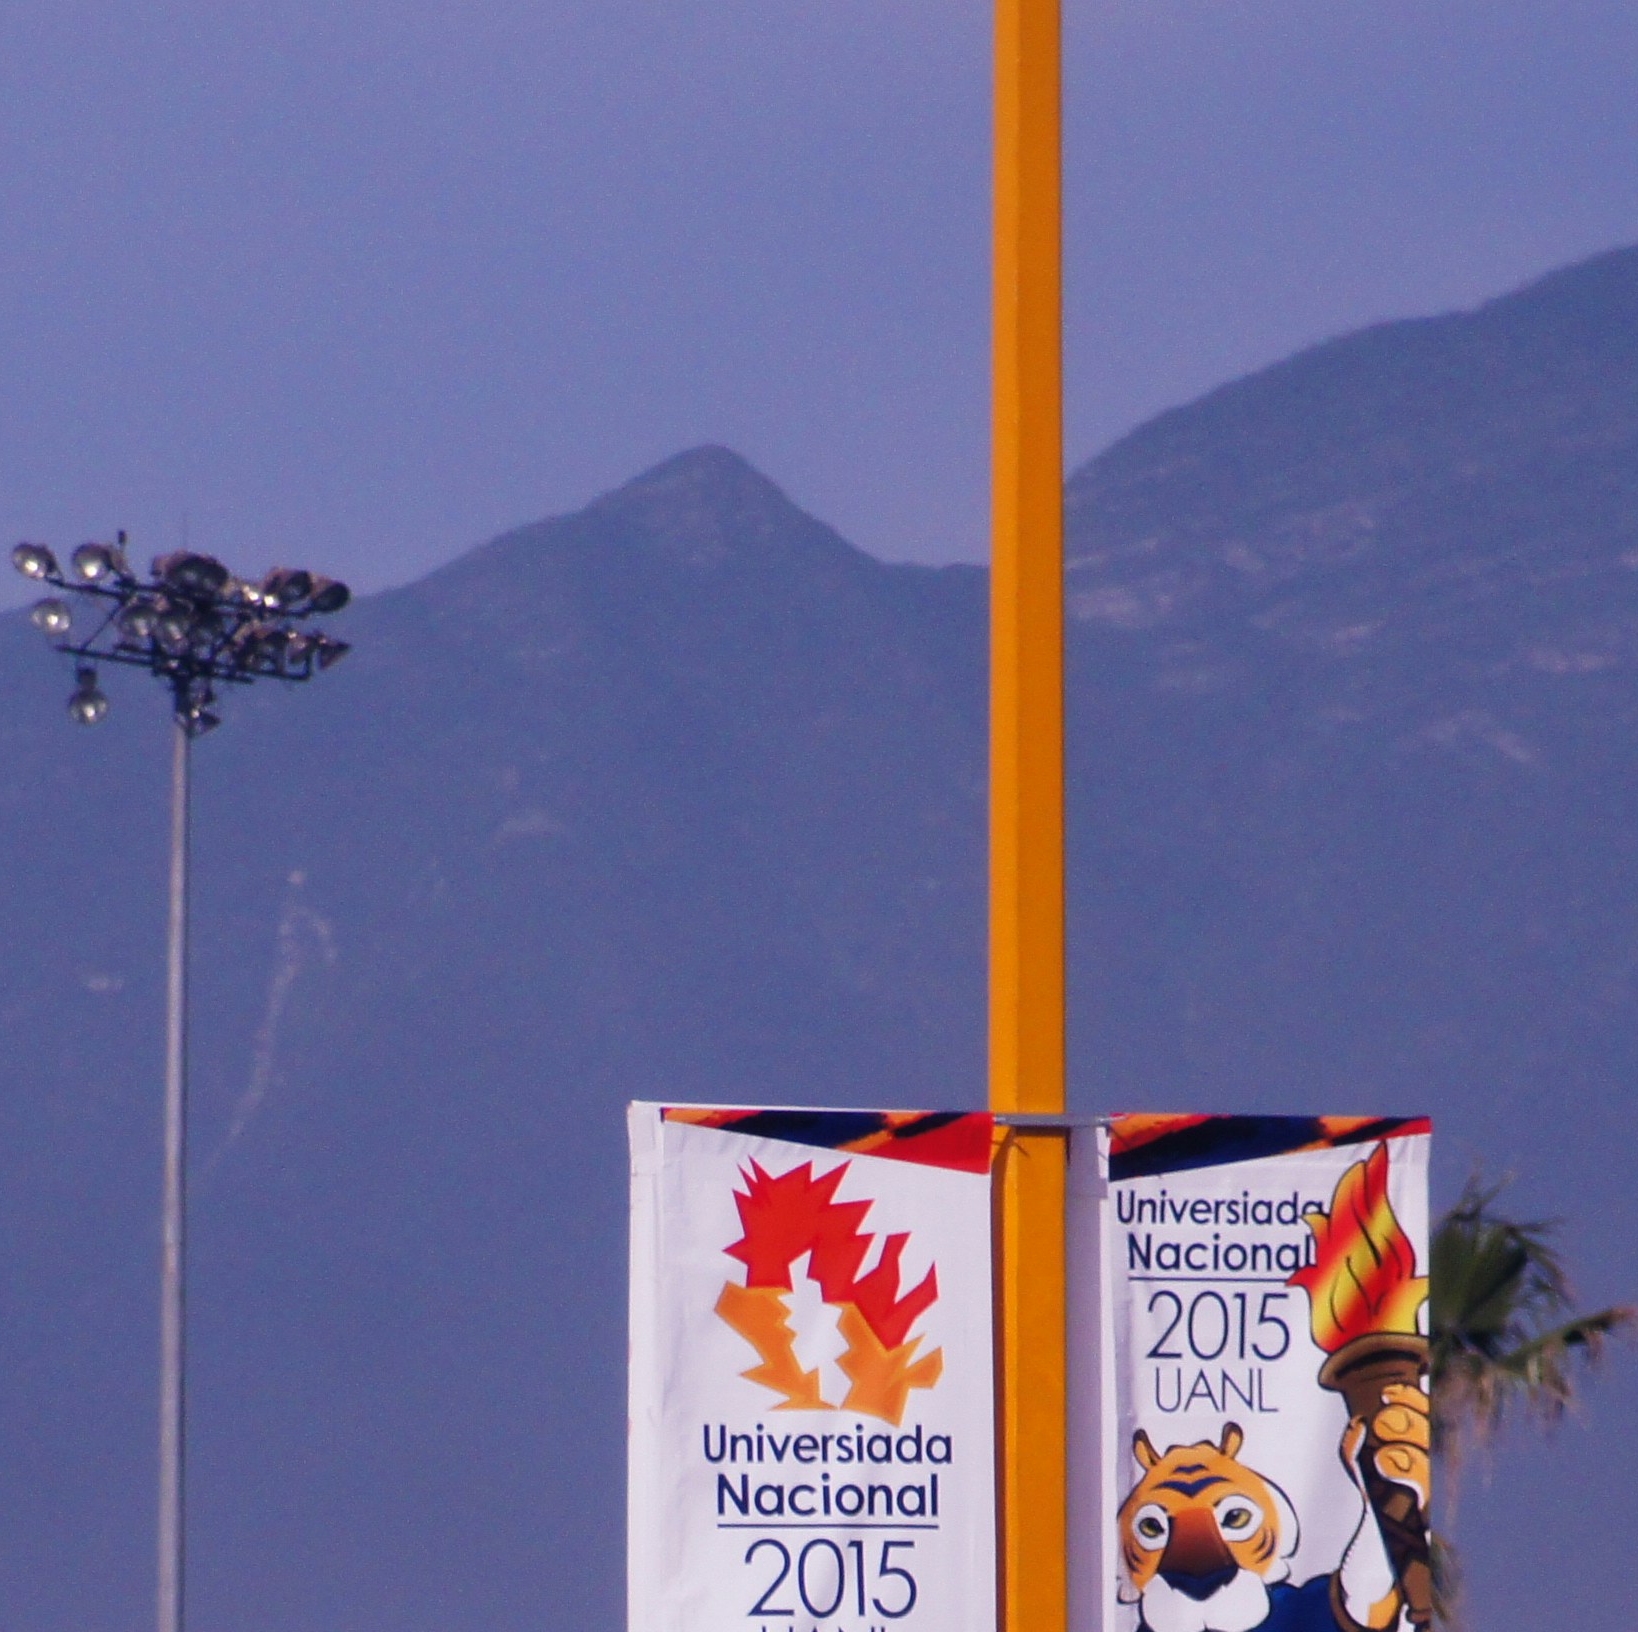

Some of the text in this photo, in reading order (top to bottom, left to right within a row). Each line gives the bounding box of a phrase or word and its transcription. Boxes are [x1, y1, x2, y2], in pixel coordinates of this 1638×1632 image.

[1128, 1232, 1311, 1271] Nacional
[1146, 1289, 1290, 1361] 2015
[1155, 1366, 1278, 1413] UANL
[703, 1423, 952, 1464] Universiada
[717, 1472, 938, 1517] Nacional
[744, 1538, 917, 1619] 2015
